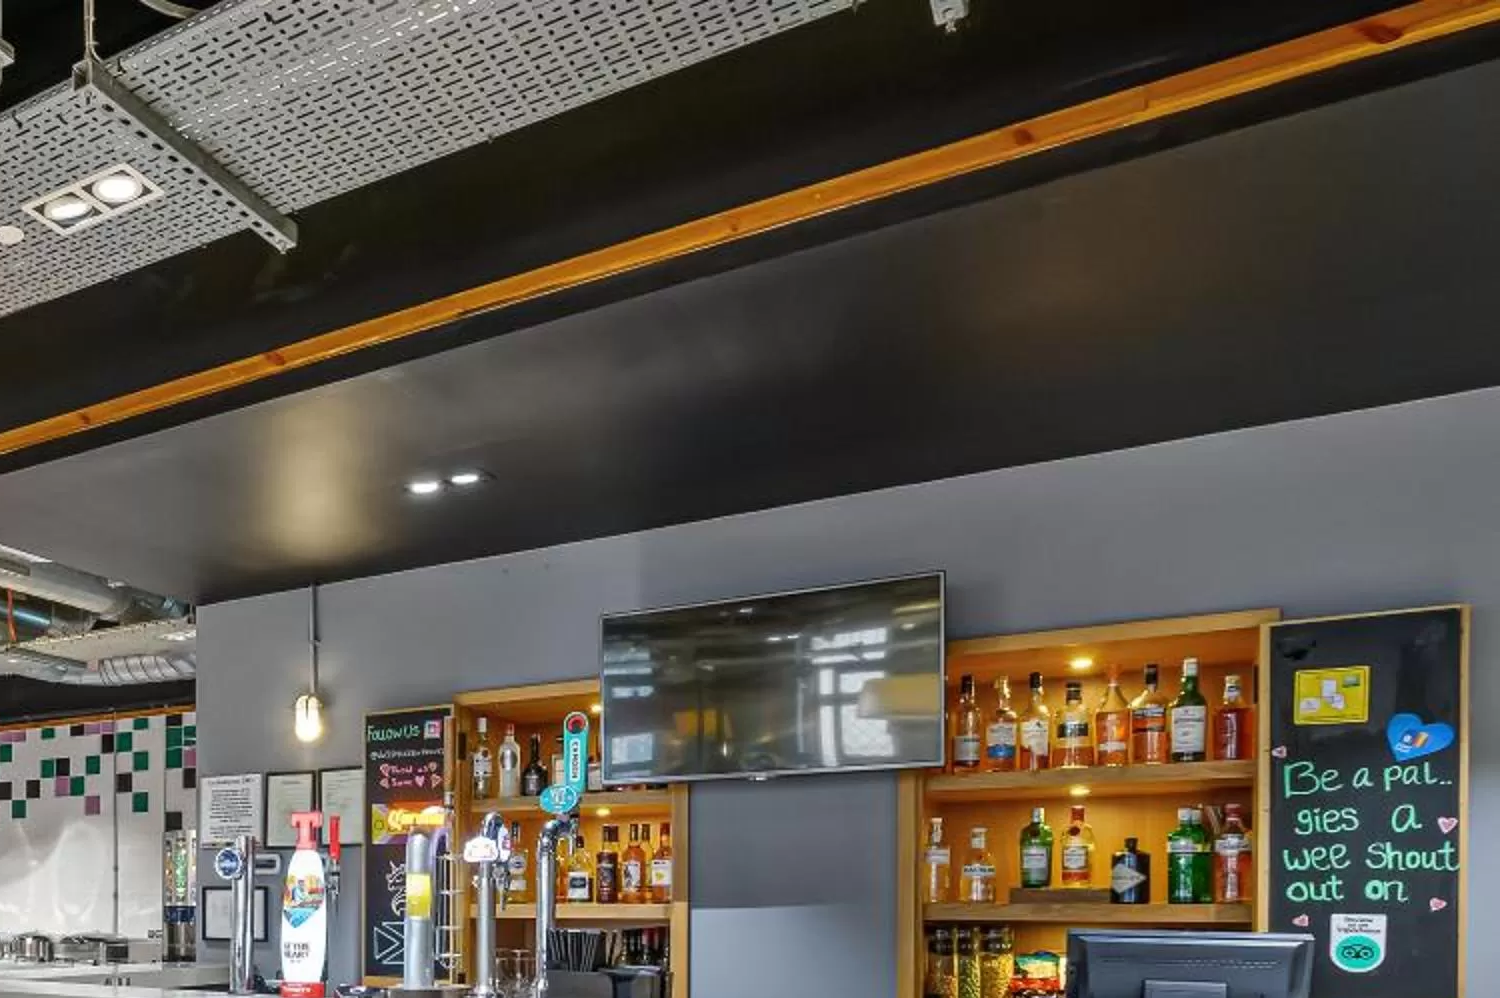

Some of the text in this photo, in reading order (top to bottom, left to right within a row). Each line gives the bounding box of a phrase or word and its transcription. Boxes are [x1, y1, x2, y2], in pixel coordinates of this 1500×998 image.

[1284, 761, 1344, 798] Be
[1352, 767, 1374, 788] a
[1295, 804, 1423, 835] gies a
[1283, 843, 1352, 871] wee
[1286, 875, 1409, 901] out on
